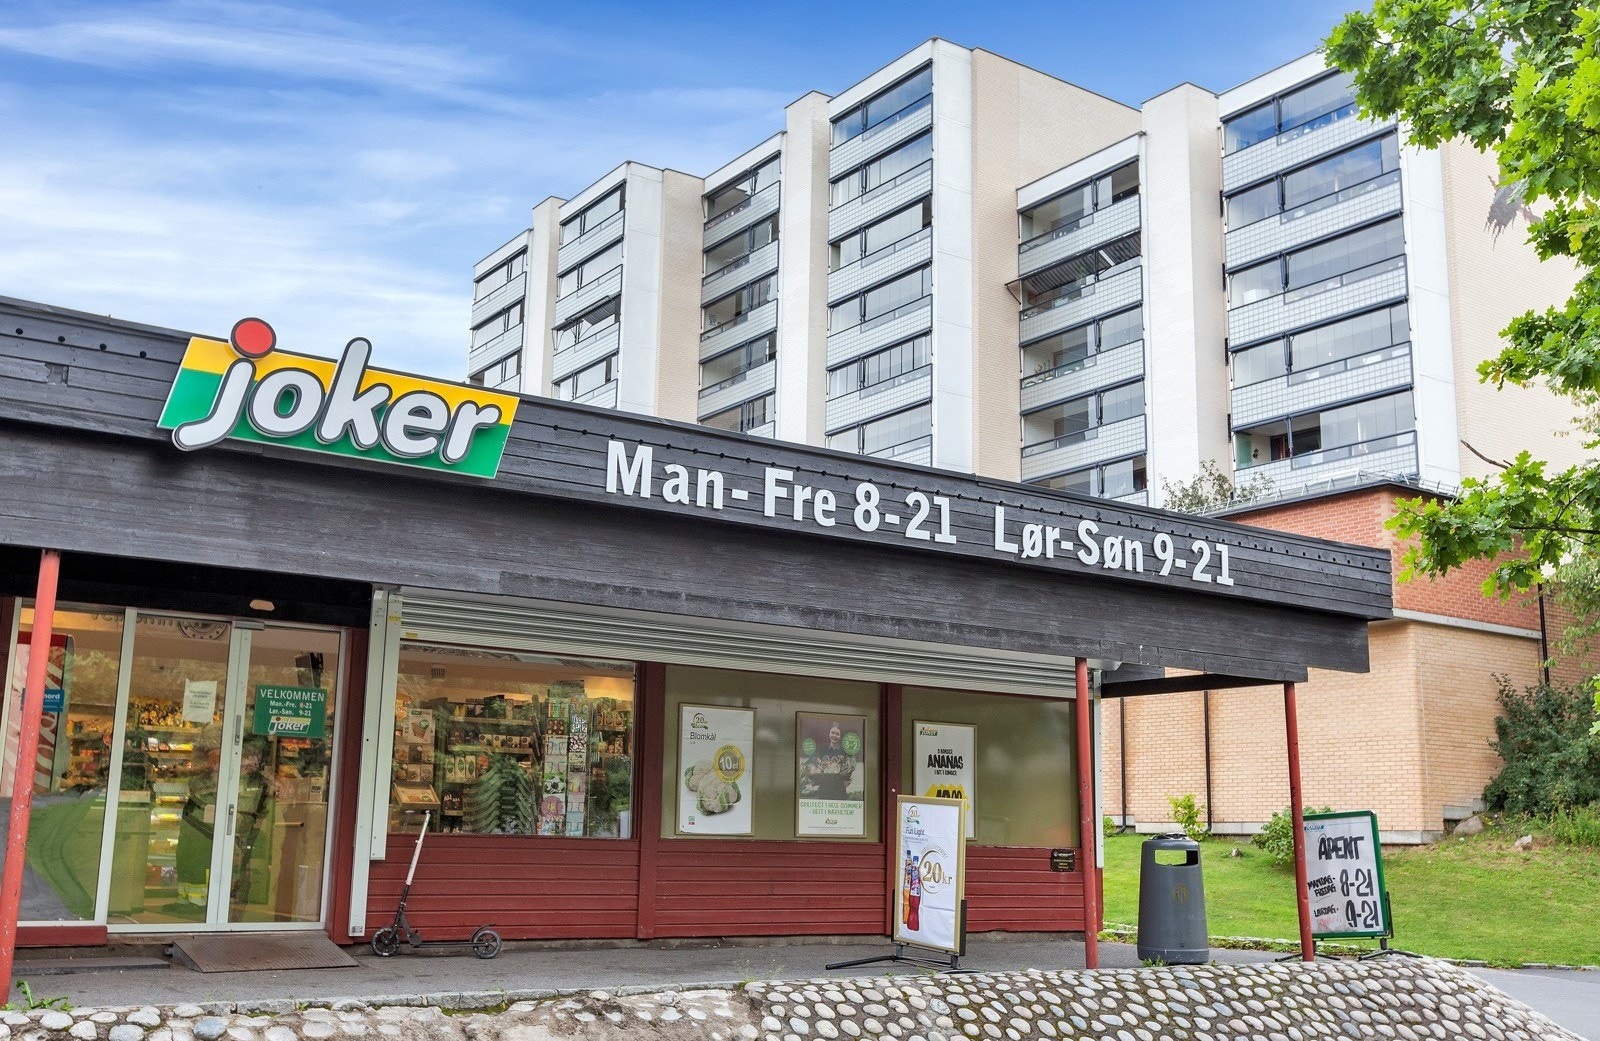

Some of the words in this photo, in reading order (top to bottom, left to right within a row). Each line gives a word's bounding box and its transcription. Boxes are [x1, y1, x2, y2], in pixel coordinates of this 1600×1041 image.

[173, 317, 502, 464] joker
[853, 481, 957, 545] 8-21
[994, 505, 1144, 573] Lør-Søn
[1152, 532, 1234, 587] 9-21
[260, 688, 325, 701] VELKOMMEN
[298, 709, 311, 717] 9-21
[269, 716, 306, 734] joker
[927, 753, 964, 770] ANANAS
[1340, 868, 1374, 897] 8-21
[1345, 899, 1380, 929] 9-21
